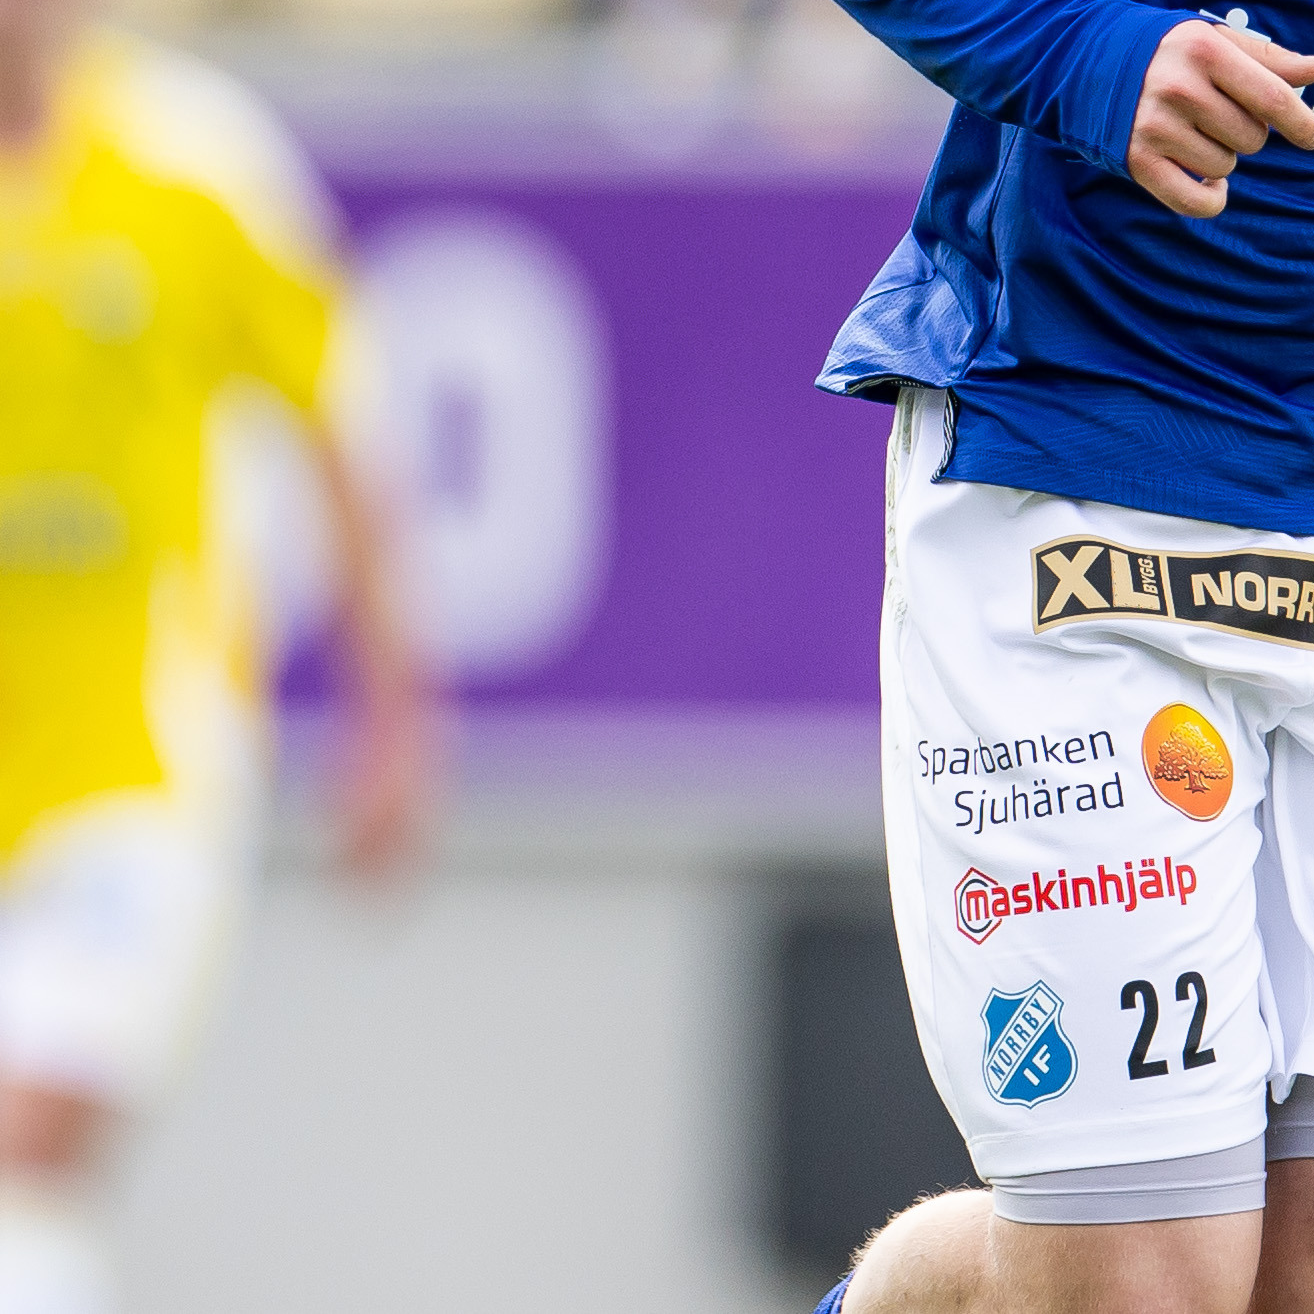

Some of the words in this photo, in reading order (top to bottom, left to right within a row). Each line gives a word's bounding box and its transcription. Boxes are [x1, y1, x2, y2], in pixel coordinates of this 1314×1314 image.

[1040, 546, 1161, 620] XL
[918, 730, 1115, 785] Sparbanken
[954, 771, 1125, 834] Sjuhärad
[965, 856, 1198, 923] maskinhjälp
[987, 999, 1053, 1082] NORRBY
[1120, 971, 1217, 1081] 22
[1022, 1047, 1054, 1086] IF
